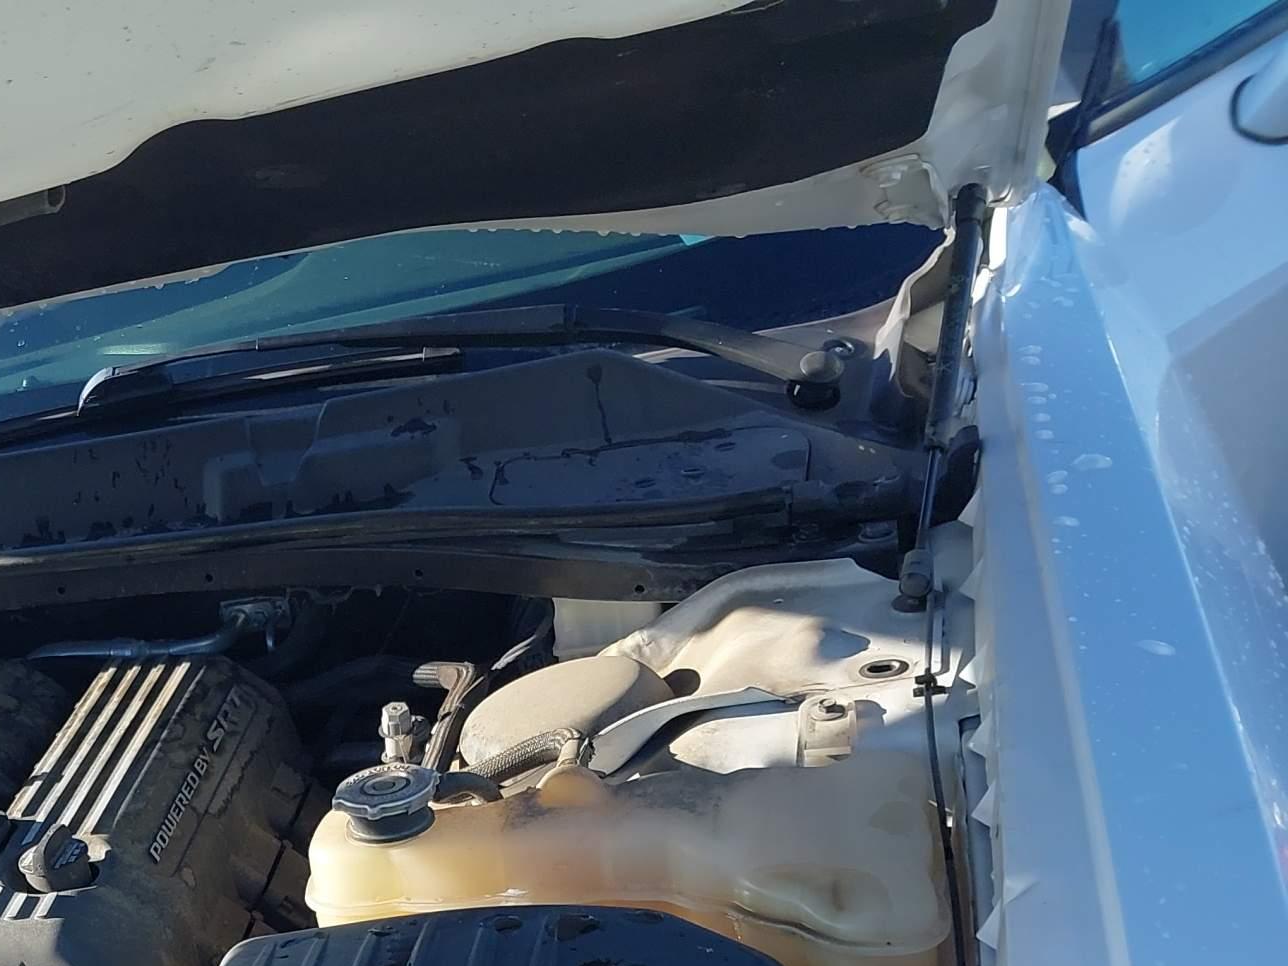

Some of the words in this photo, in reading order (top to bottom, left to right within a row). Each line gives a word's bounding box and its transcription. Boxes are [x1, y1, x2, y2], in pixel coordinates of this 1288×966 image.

[149, 772, 200, 863] POWERED
[194, 747, 211, 777] BY
[206, 684, 248, 752] SRT
